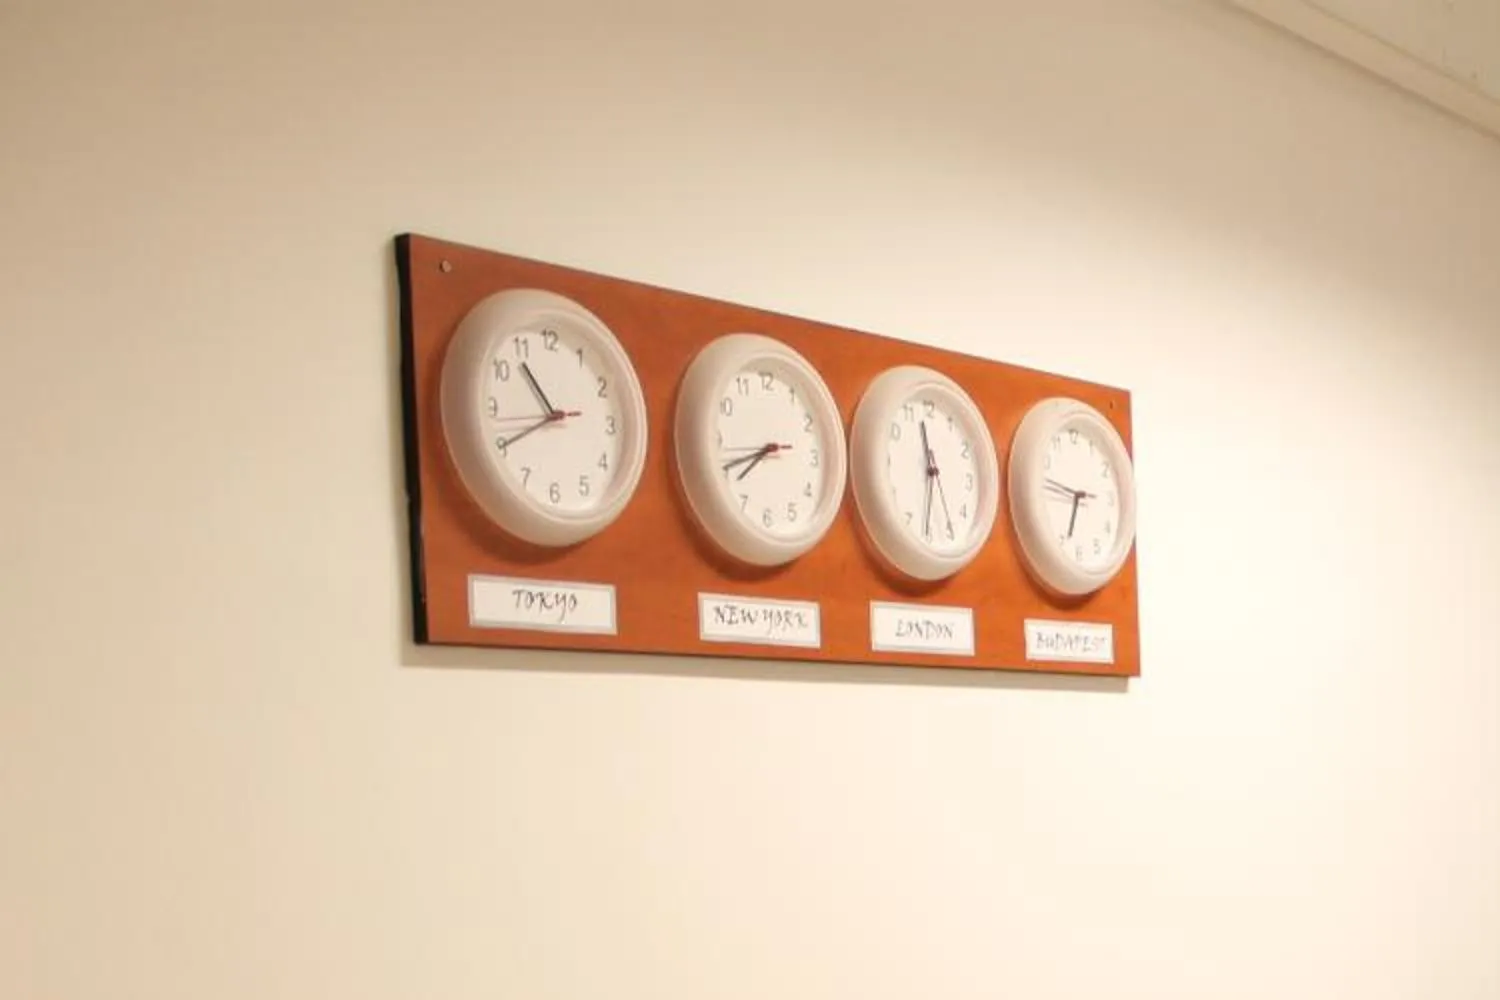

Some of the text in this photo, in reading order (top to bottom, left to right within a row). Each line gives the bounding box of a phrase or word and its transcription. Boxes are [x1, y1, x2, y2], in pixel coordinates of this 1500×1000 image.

[514, 336, 529, 358] 11
[542, 328, 559, 352] 12
[576, 348, 584, 368] 1
[493, 358, 510, 382] 10
[597, 376, 608, 398] 2
[736, 377, 750, 396] 11
[758, 372, 774, 391] 12
[720, 396, 733, 417] 10
[903, 403, 914, 423] 11
[606, 415, 617, 436] 3
[804, 413, 813, 433] 2
[810, 449, 818, 468] 3
[961, 439, 970, 460] 2
[598, 452, 608, 471] 4
[521, 467, 532, 488] 7
[579, 475, 589, 497] 5
[549, 482, 561, 504] 6
[739, 494, 749, 513] 7
[762, 507, 773, 529] 6
[787, 502, 798, 522] 5
[512, 588, 579, 622] TOKYO
[713, 604, 808, 636] NEW YORK
[895, 619, 954, 640] LONDON
